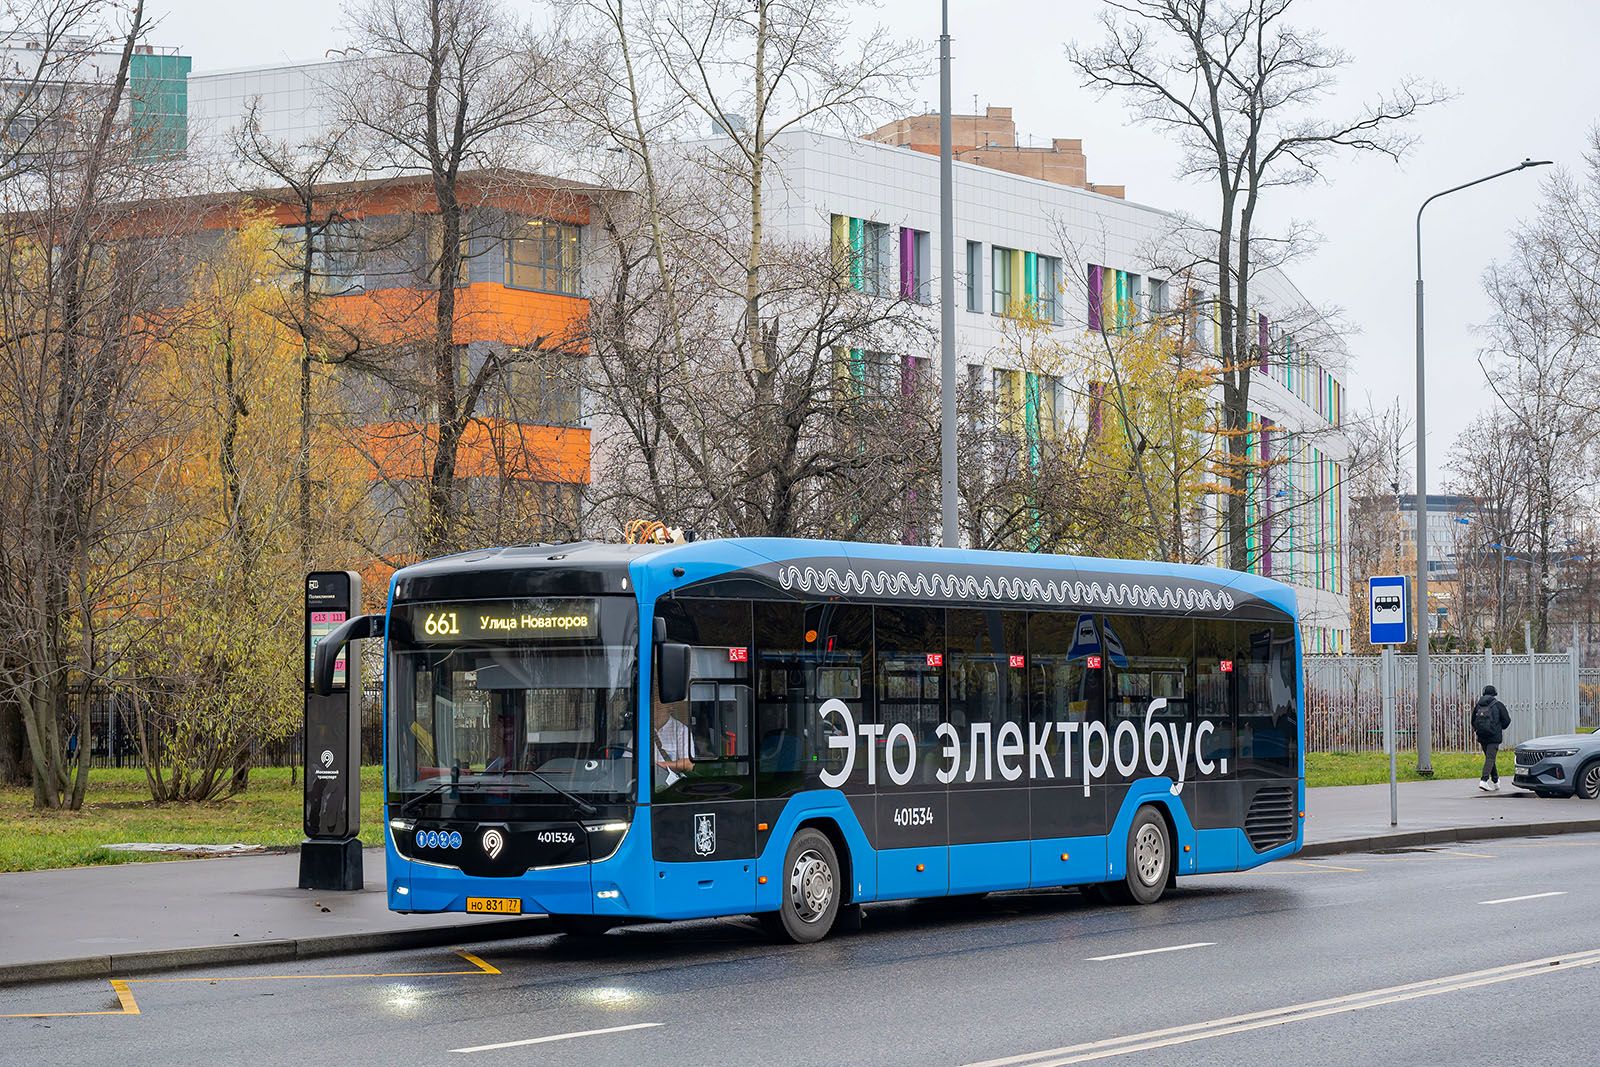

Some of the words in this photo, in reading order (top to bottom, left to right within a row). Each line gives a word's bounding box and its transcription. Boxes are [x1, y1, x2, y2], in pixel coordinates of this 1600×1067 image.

[425, 613, 459, 635] 661
[480, 616, 517, 631] Улица
[521, 615, 588, 630] Новаторов
[818, 698, 917, 788] Это
[935, 697, 1227, 797] электробус.
[893, 806, 934, 826] 401534
[537, 831, 576, 843] 401534
[486, 899, 503, 911] 831
[508, 899, 518, 908] 77
